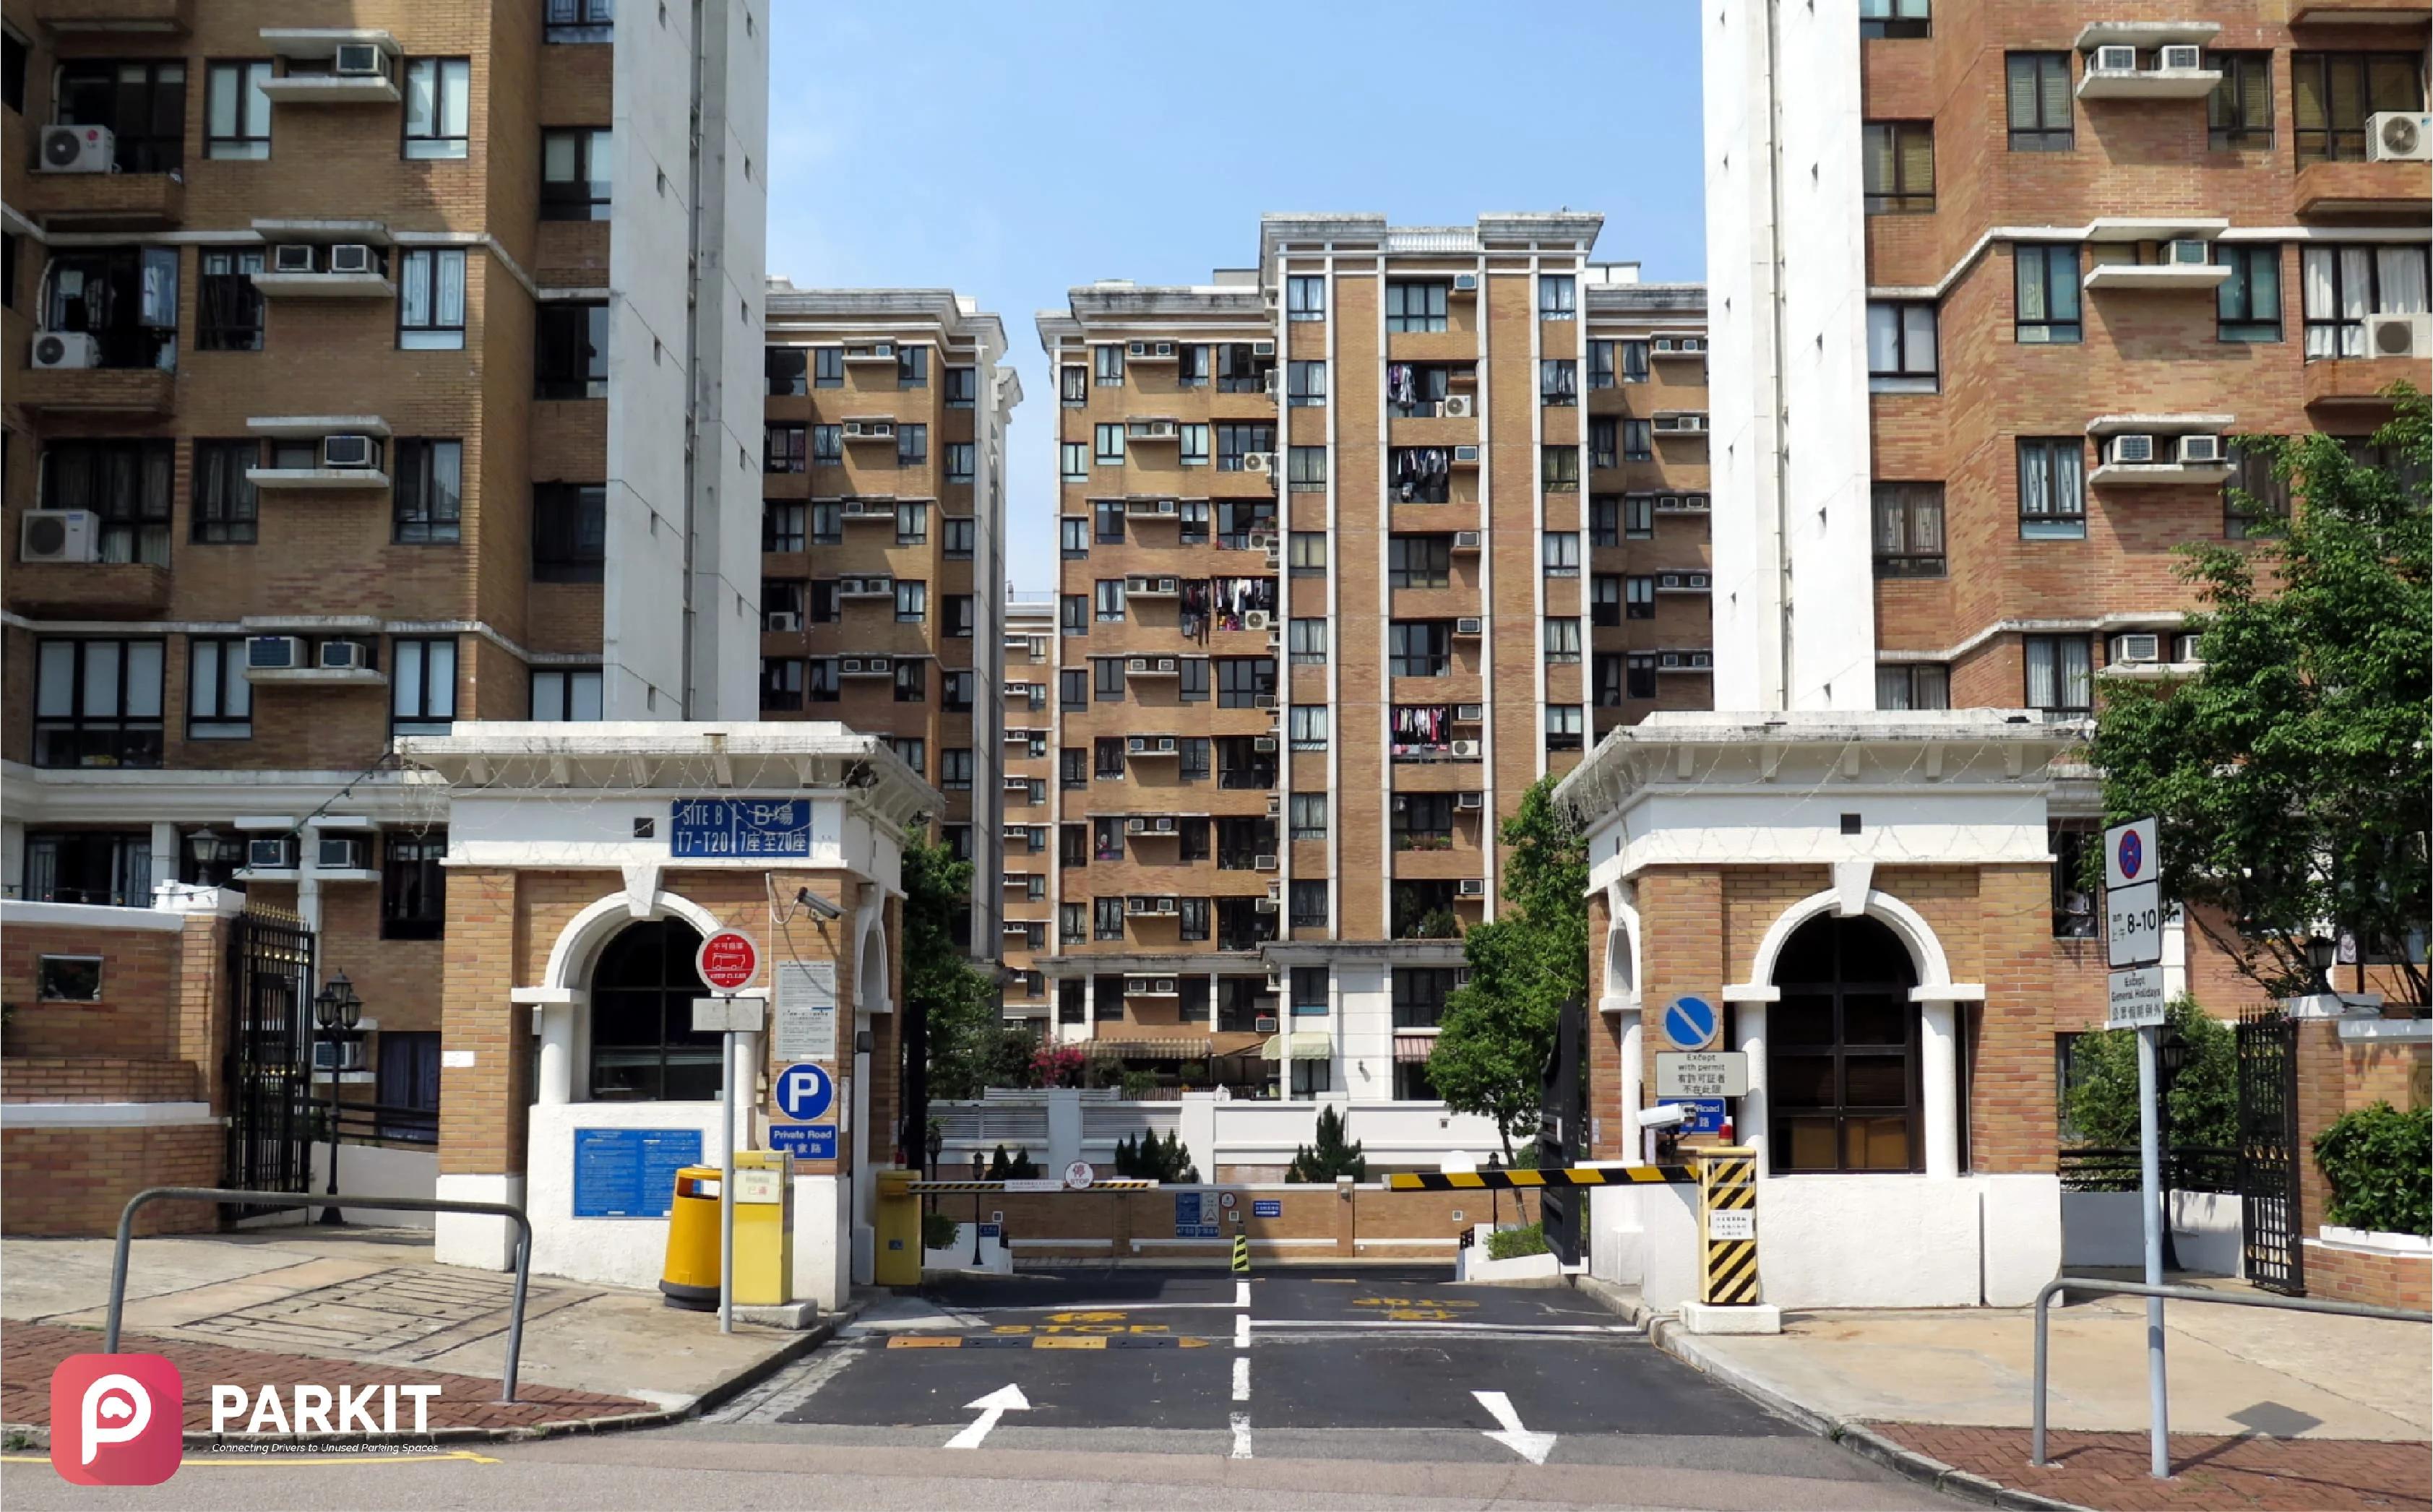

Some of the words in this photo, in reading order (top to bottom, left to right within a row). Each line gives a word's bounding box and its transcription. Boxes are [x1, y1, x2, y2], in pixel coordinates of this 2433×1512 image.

[683, 805, 708, 826] SITE
[715, 805, 723, 826] B
[676, 831, 728, 852] T7-T20
[740, 831, 806, 852] 7座至20座
[2128, 909, 2156, 934] 8-10
[2111, 928, 2126, 942] 上午
[2124, 976, 2145, 987] Except
[2111, 990, 2133, 1002] General
[2135, 988, 2161, 998] Holidays
[789, 1073, 819, 1113] P
[1696, 1104, 1720, 1113] Road
[774, 1130, 805, 1139] Private
[808, 1130, 832, 1139] Road
[991, 1324, 1170, 1334] STOP
